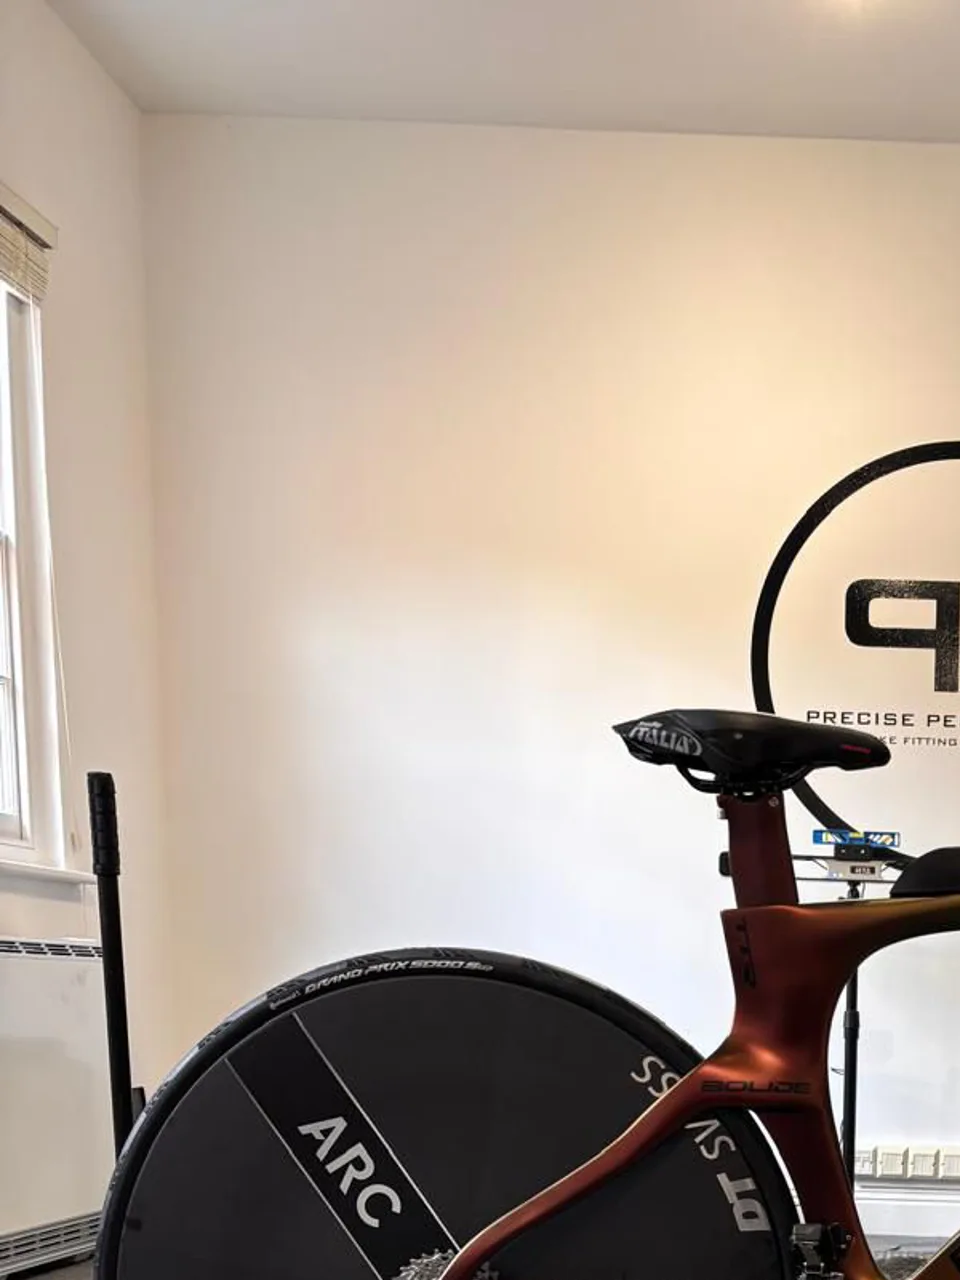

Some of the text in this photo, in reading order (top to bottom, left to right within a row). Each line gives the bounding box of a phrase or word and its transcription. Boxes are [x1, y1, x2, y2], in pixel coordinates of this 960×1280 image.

[806, 709, 915, 728] PRECISE
[628, 726, 690, 755] ITALIA
[902, 736, 959, 748] FITTING
[304, 968, 364, 995] GRAND
[363, 960, 409, 976] PRIX
[409, 959, 464, 970] 5000
[701, 1080, 811, 1095] BOLIDE
[297, 1116, 402, 1228] ARC
[716, 1172, 772, 1231] DT
